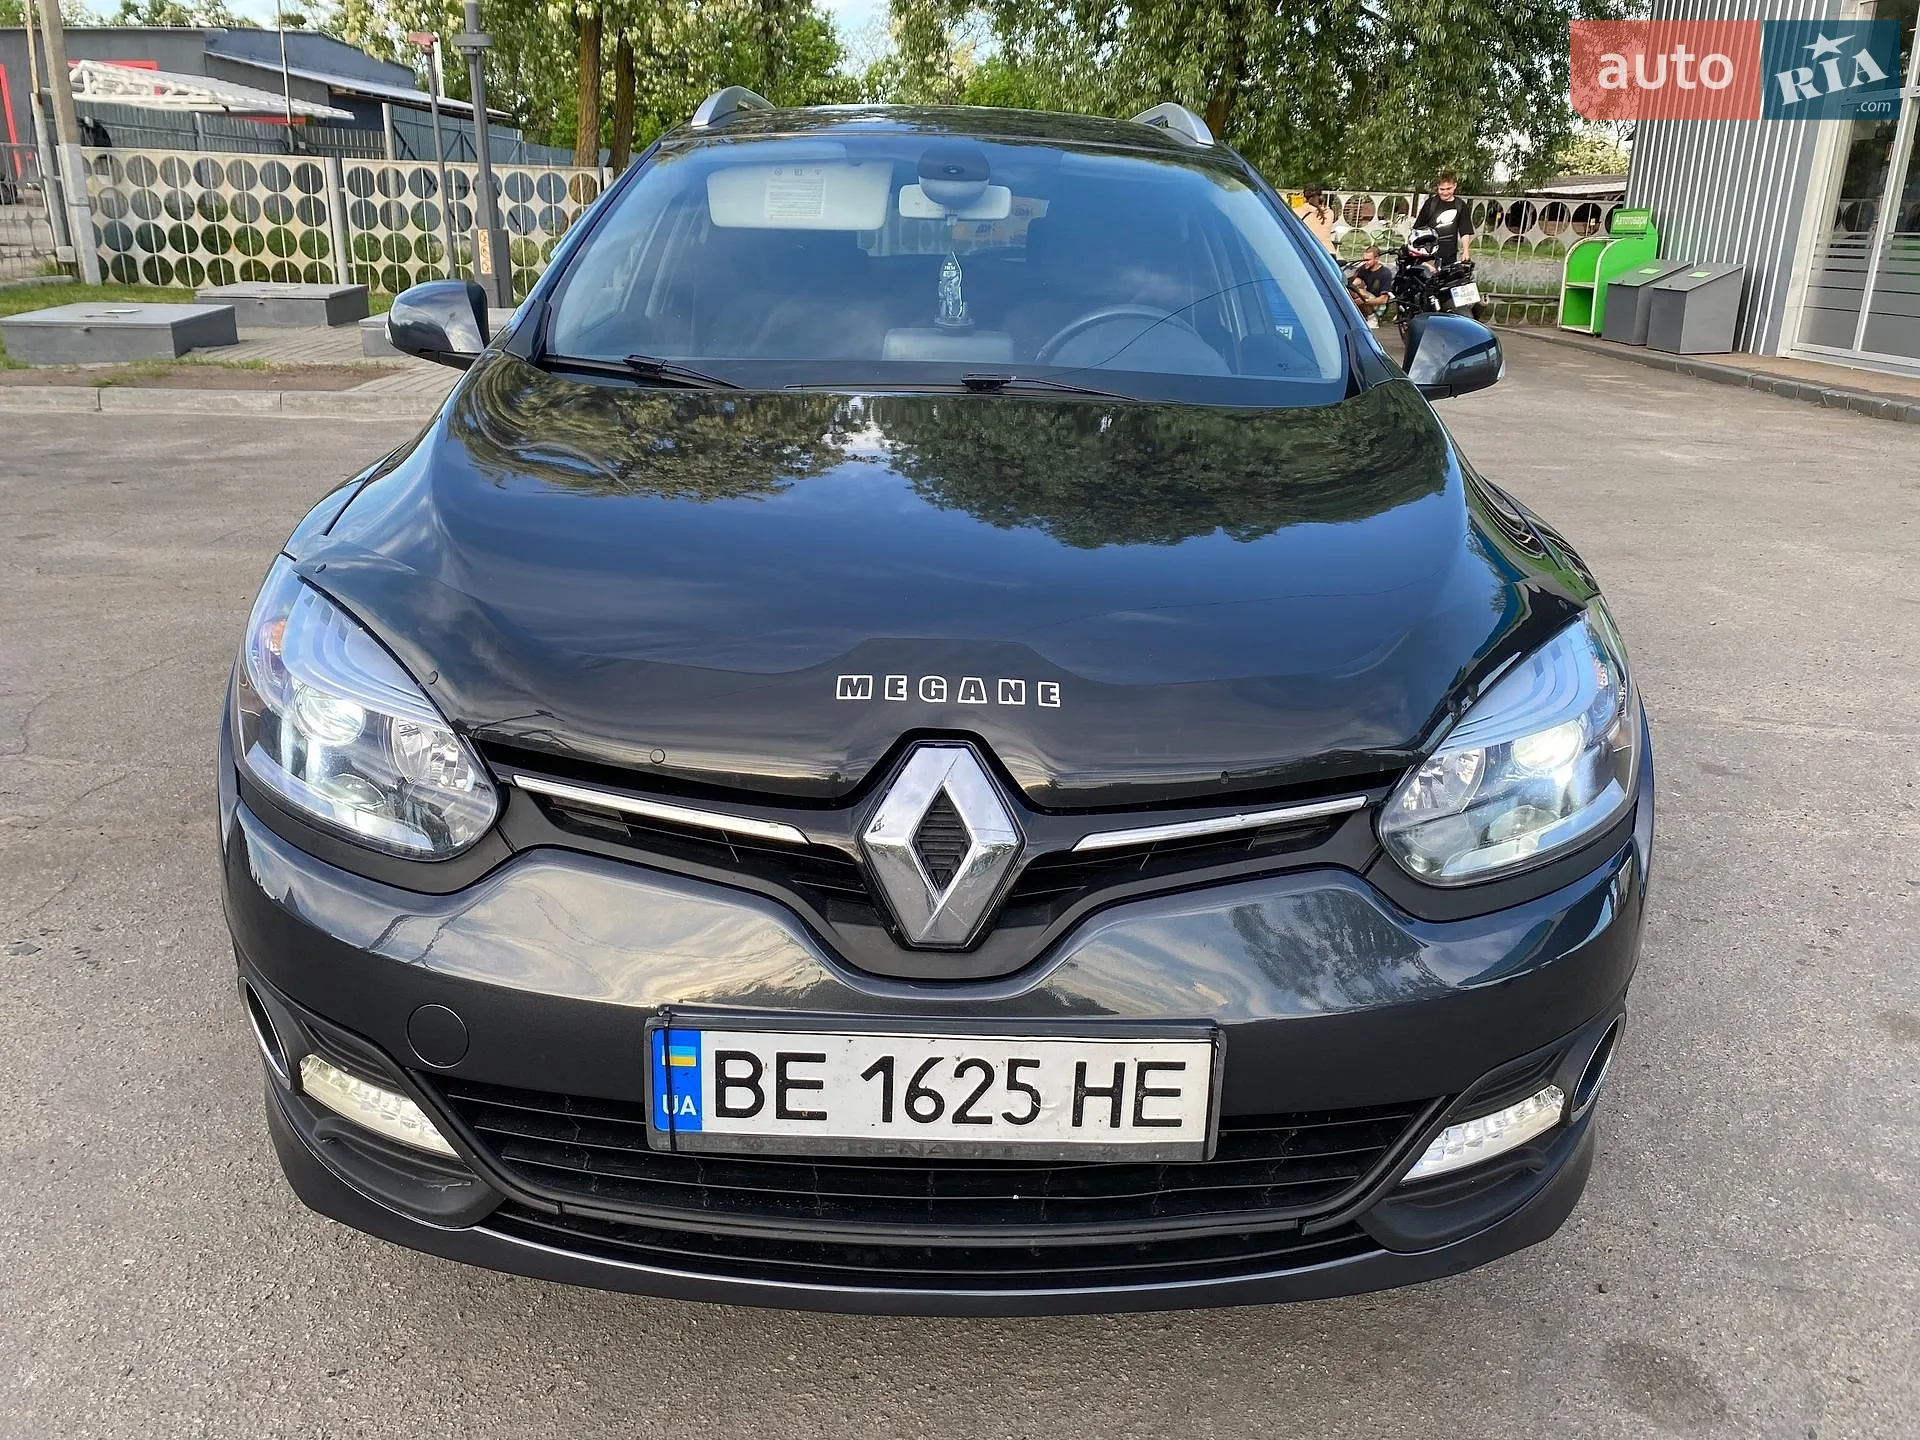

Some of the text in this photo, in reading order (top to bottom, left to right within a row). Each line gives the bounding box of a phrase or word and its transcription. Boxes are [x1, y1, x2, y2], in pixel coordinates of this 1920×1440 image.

[835, 674, 1061, 708] MEGANE
[661, 1094, 698, 1116] UA
[715, 1049, 1187, 1129] BE 1625 HE
